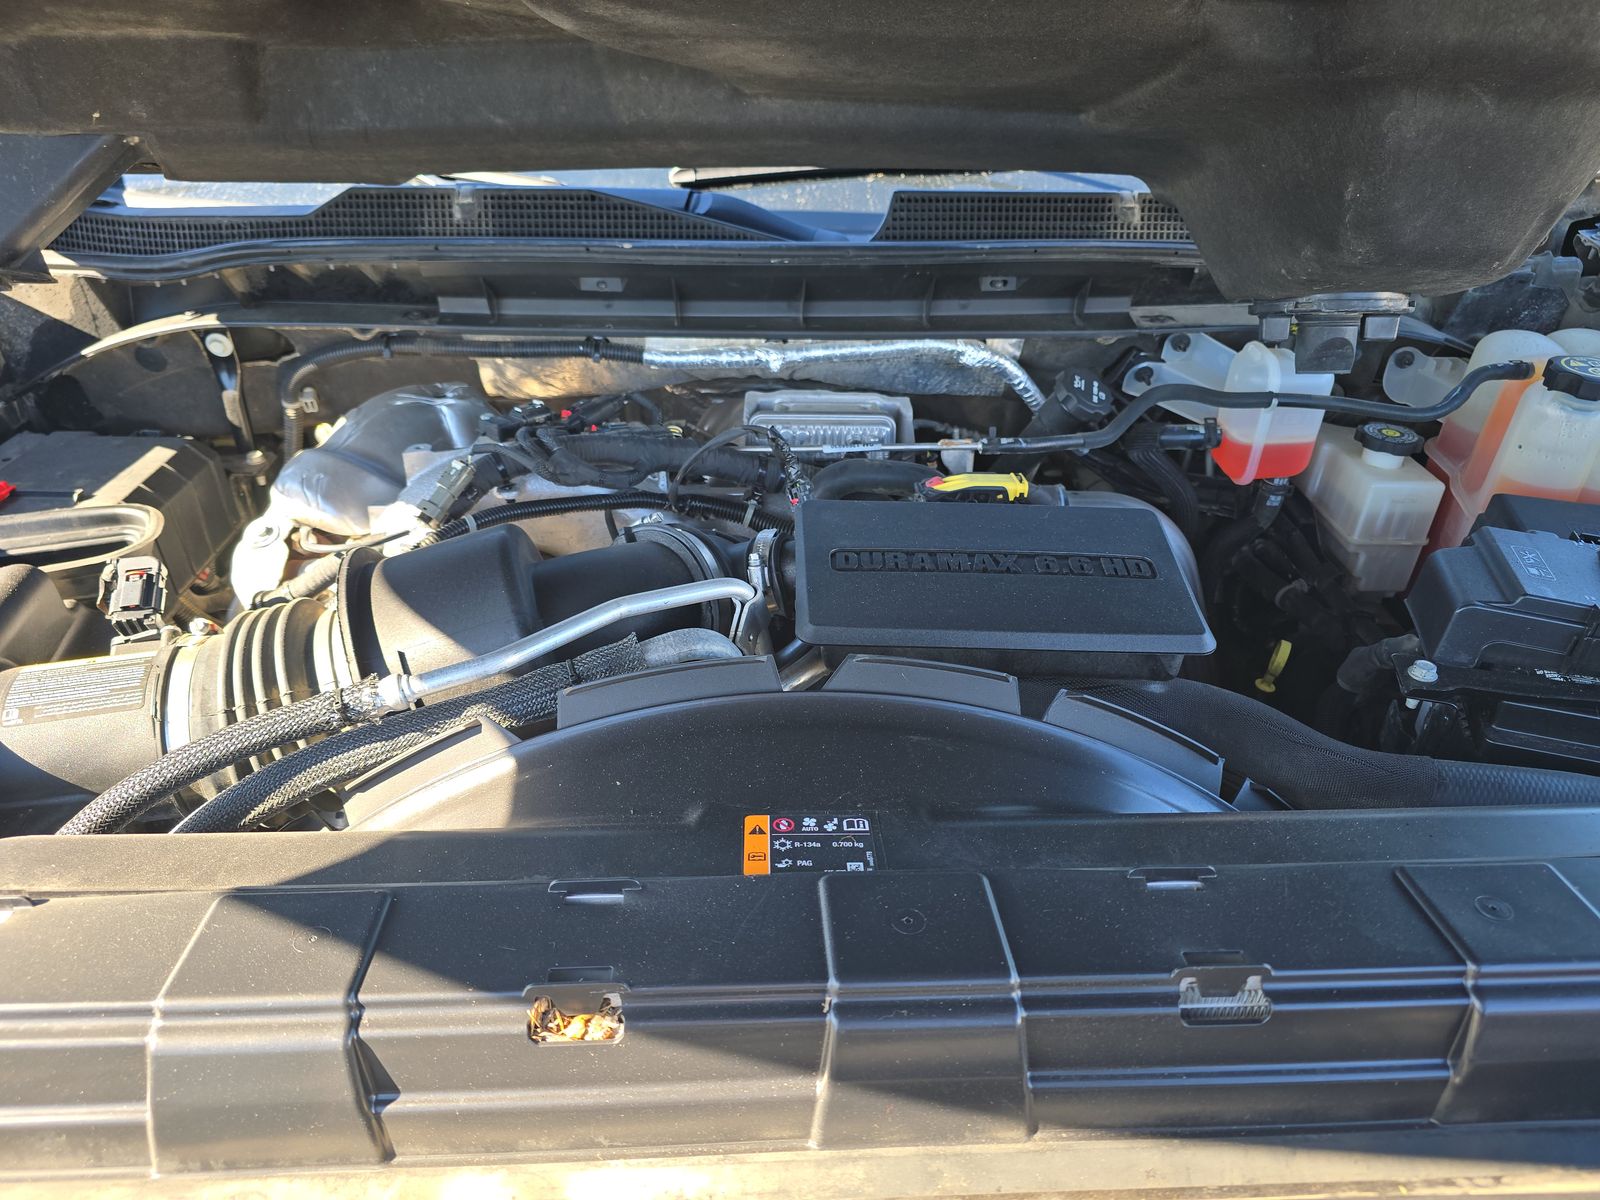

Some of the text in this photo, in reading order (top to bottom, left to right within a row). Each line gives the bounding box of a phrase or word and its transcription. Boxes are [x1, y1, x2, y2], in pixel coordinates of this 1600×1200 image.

[833, 550, 1154, 578] DURAMAX 6.6 HD
